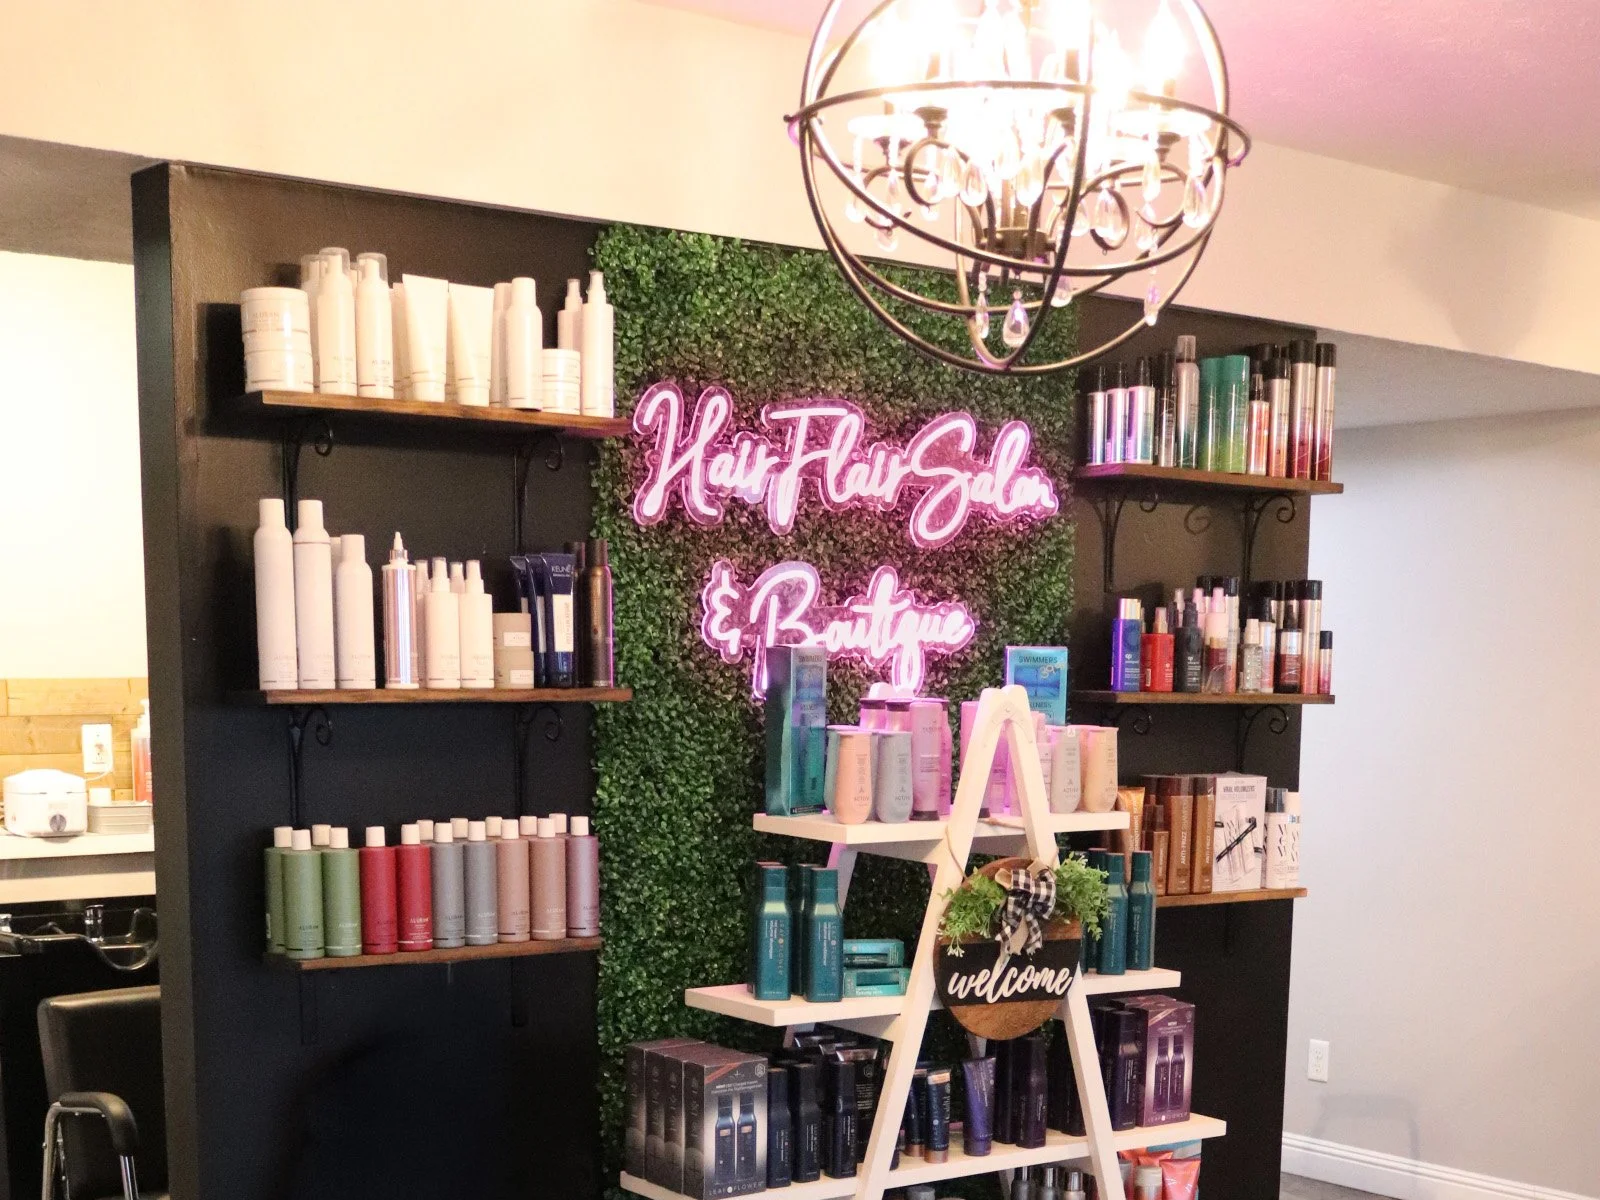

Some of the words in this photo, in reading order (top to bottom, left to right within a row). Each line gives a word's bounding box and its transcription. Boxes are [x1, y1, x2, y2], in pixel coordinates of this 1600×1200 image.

[637, 386, 773, 520] Hair
[764, 404, 906, 530] Flair
[907, 416, 1057, 543] Salon
[706, 564, 744, 658] &
[749, 566, 973, 694] Boutique
[1018, 656, 1058, 664] SWIMMERS
[948, 951, 1072, 1004] welcome
